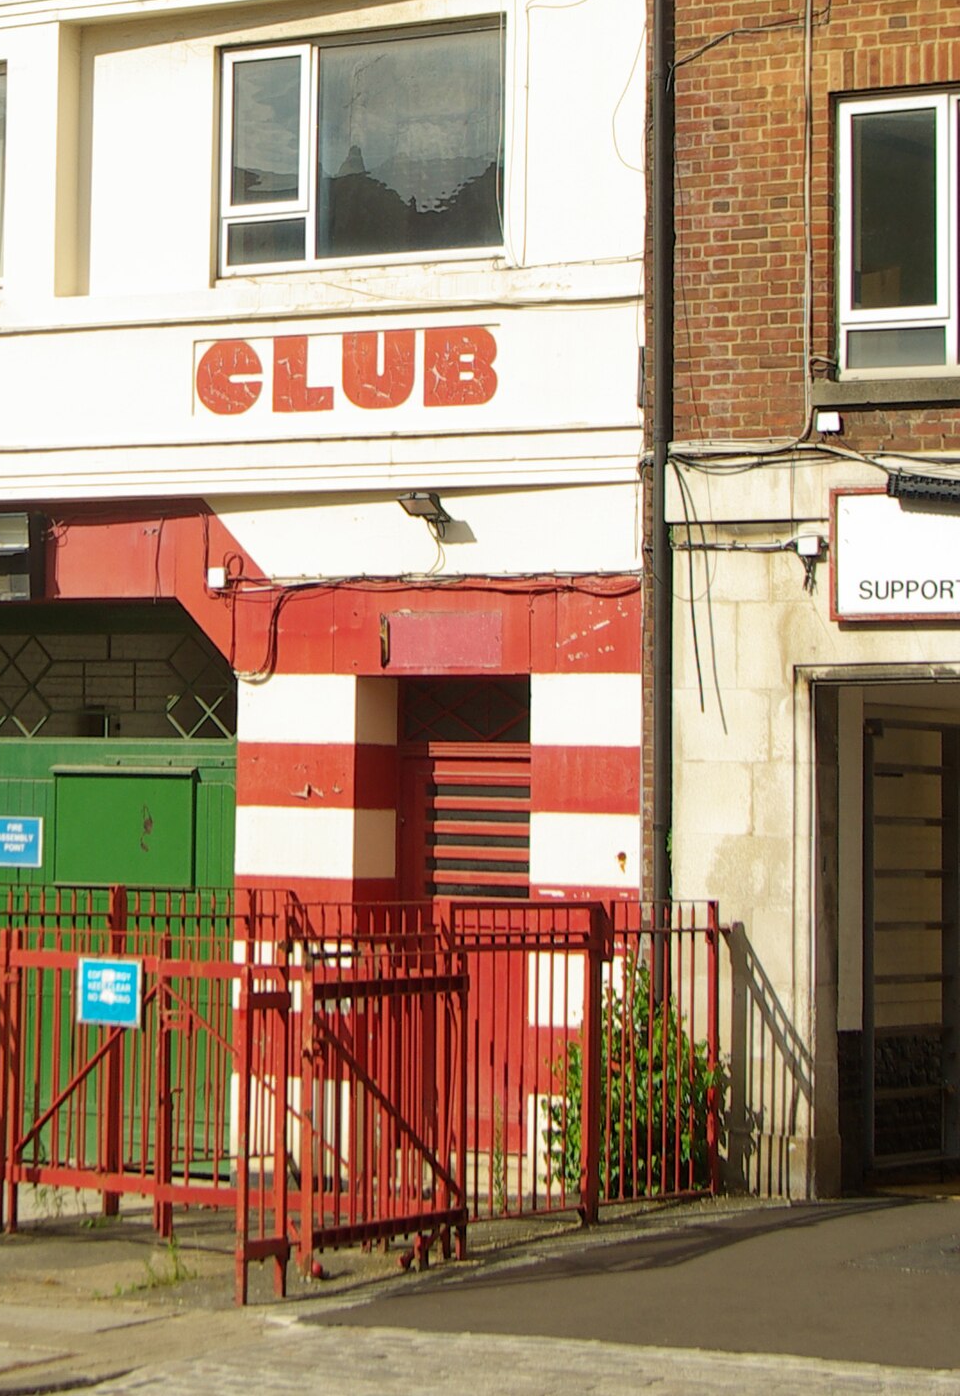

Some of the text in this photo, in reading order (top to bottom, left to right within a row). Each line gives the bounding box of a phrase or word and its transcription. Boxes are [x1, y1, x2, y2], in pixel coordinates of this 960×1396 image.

[196, 325, 498, 416] CLUB
[6, 823, 23, 832] FIRE
[3, 843, 25, 852] POINT
